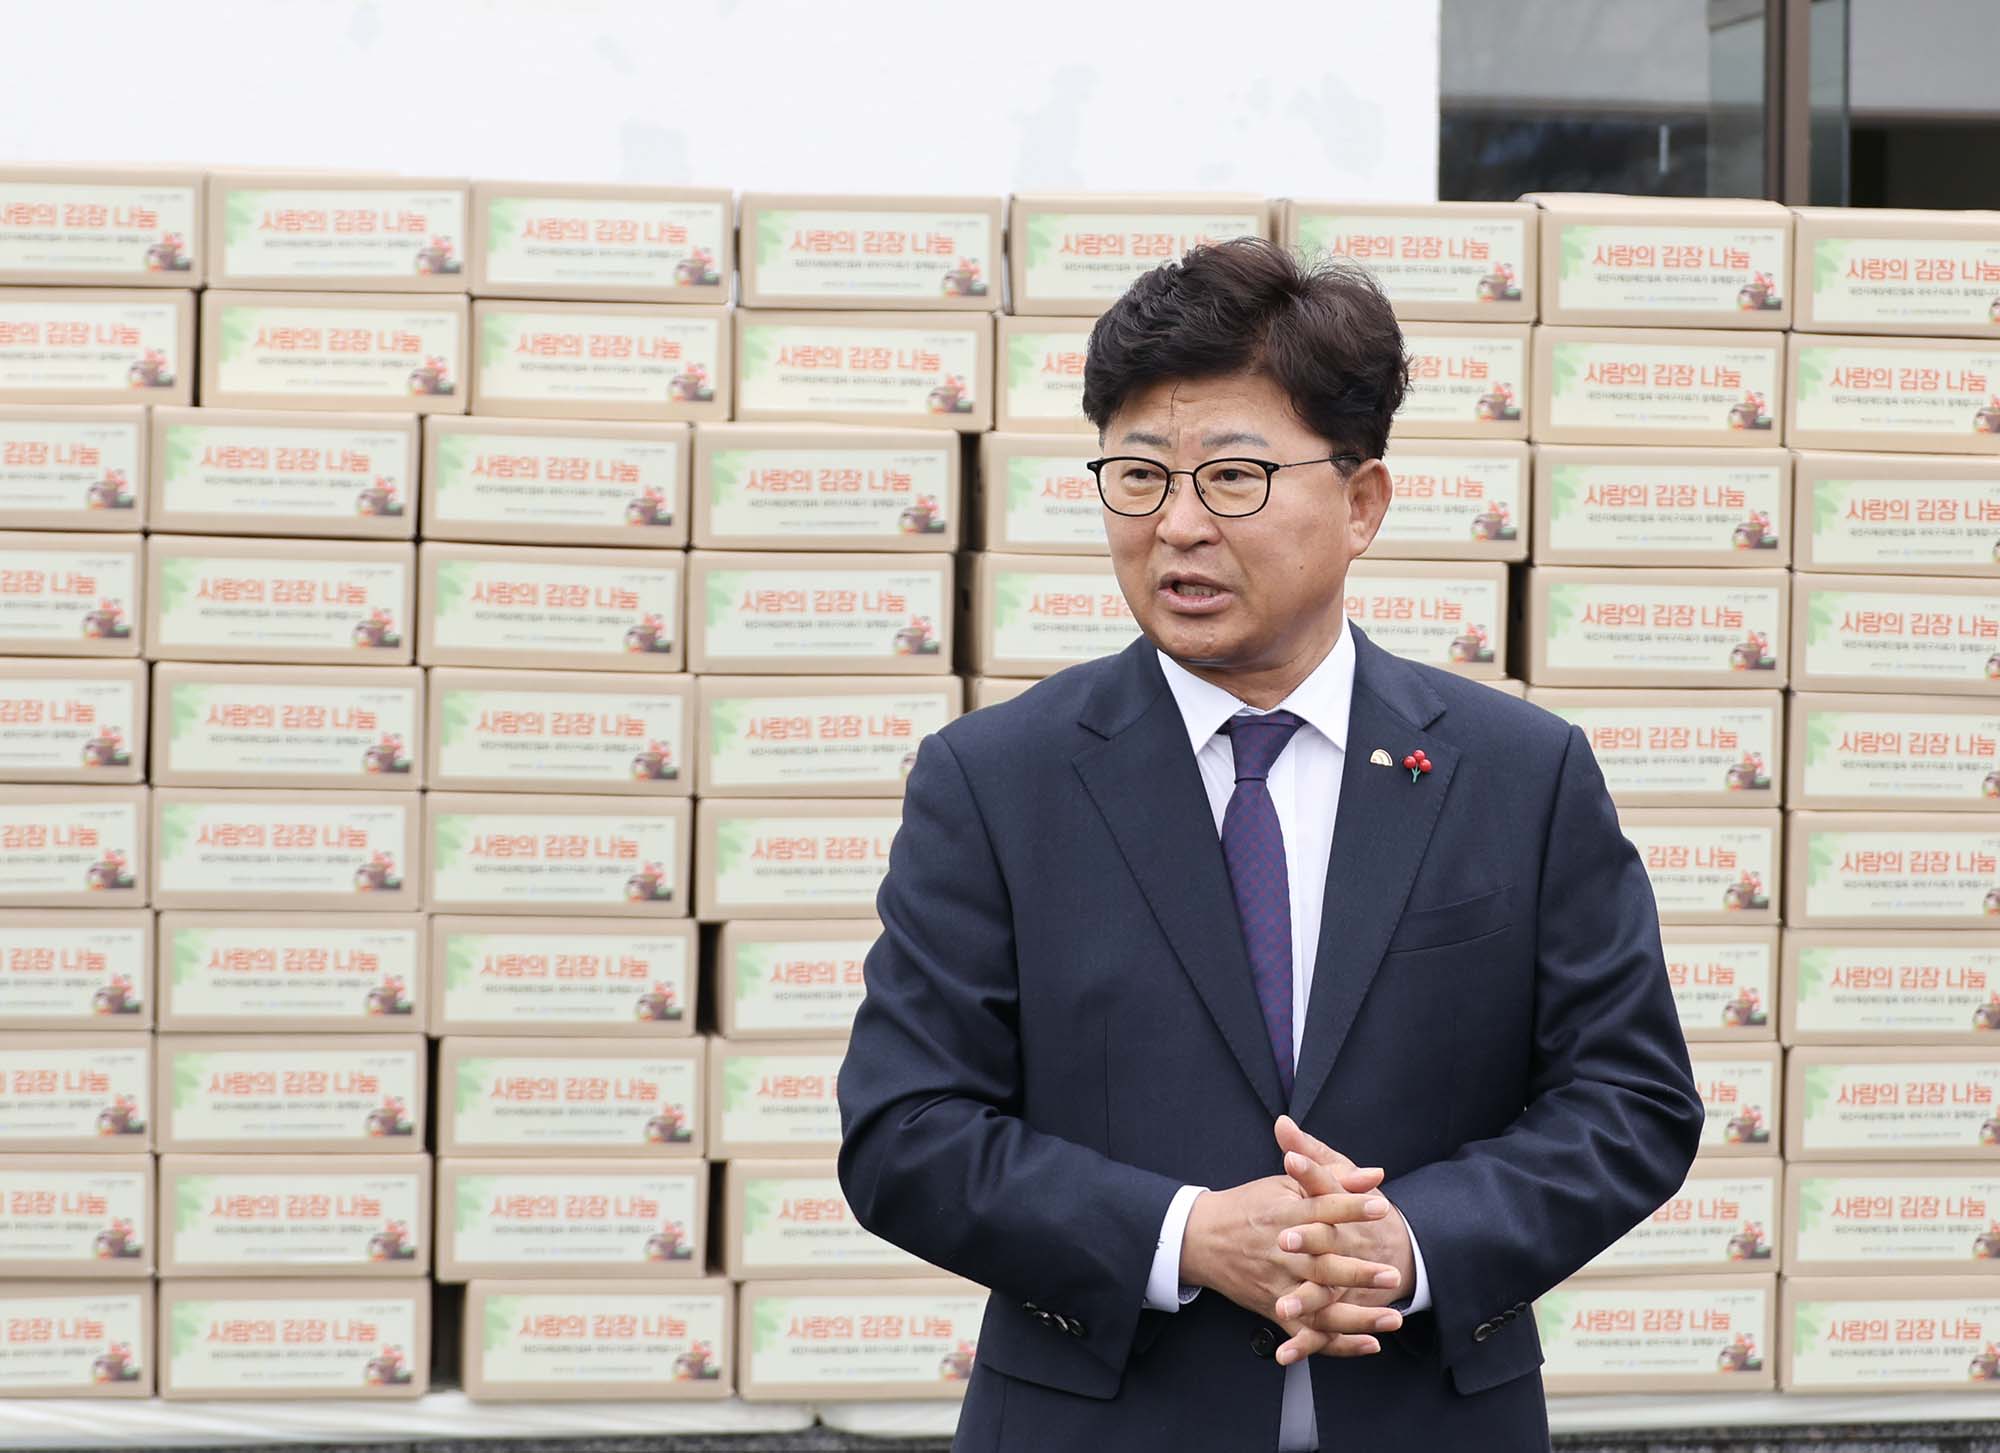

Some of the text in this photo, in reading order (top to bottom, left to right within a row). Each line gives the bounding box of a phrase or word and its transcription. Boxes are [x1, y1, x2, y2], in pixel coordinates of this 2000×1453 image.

[62, 205, 159, 231] 김장 나눔
[259, 209, 428, 236] 사랑의 김장 나눔
[522, 217, 689, 246] 사랑의 김장 나눔
[789, 230, 956, 257] 사랑의 김장 나눔
[1061, 233, 1173, 257] 사랑의 김장
[1331, 235, 1490, 262] 사랑의 김장 나눔
[1593, 244, 1752, 272] 사랑의 김장 나눔
[1846, 257, 2000, 288] 사랑의 김장 나눔
[46, 322, 145, 348] 김장 나눔
[255, 327, 422, 354] 사랑의 김장 나눔
[515, 334, 682, 361] 사랑의 김장 나눔
[776, 345, 944, 375] 사랑의 김장 나눔
[1584, 362, 1742, 388] 사랑의 김장 나눔
[1828, 367, 1987, 394] 사랑의 김장 나눔
[2, 441, 100, 469] 김장 나눔
[201, 447, 372, 475] 사랑의 김장 나눔
[472, 453, 641, 485] 사랑의 김장 나눔
[744, 469, 913, 495] 사랑의 김장 나눔
[1392, 476, 1485, 501] 김장 나눔
[1583, 483, 1748, 512] 사랑의 김장 나눔
[1846, 498, 2000, 529] 사랑의 김장 나눔
[196, 579, 369, 608] 사랑의 김장 나눔
[469, 581, 640, 611] 사랑의 김장 나눔
[736, 590, 907, 616] 사랑의 김장 나눔
[1029, 593, 1094, 619] 사랑의
[1373, 595, 1463, 622] 김장 나눔
[1582, 602, 1745, 631] 사랑의 김장 나눔
[1839, 609, 2000, 641] 사랑의 김장 나눔
[0, 700, 96, 725] 김장 나눔
[205, 703, 379, 732] 사랑의 김장 나눔
[747, 714, 913, 743] 사랑의 김장 나눔
[1648, 727, 1740, 752] 김장 나눔
[1839, 731, 1998, 760] 사랑의 김장 나눔
[0, 825, 97, 851] 김장 나눔
[195, 824, 369, 850] 사랑의 김장 나눔
[468, 834, 640, 863] 사랑의 김장 나눔
[750, 835, 869, 863] 사랑의 김장
[1648, 846, 1737, 872] 김장 나눔
[1839, 851, 1999, 877] 사랑의 김장 나눔
[10, 949, 107, 974] 김장 나눔
[207, 949, 380, 975] 사랑의 김장 나눔
[771, 961, 837, 986] 사랑의
[1693, 965, 1735, 987] 나눔
[1828, 966, 1988, 993] 사랑의 김장 나눔
[489, 1077, 660, 1105] 사랑의 김장 나눔
[757, 1076, 824, 1101] 사랑의
[1836, 1082, 1994, 1108] 사랑의 김장 나눔
[208, 1195, 383, 1221] 사랑의 김장 나눔
[490, 1195, 658, 1221] 사랑의 김장 나눔
[777, 1200, 846, 1225] 사랑의
[1652, 1196, 1740, 1225] 김장 나눔
[1830, 1196, 1988, 1221] 사랑의 김장 나눔
[7, 1317, 105, 1344] 김장 나눔
[207, 1320, 379, 1345] 사랑의 김장 나눔
[517, 1315, 688, 1341] 사랑의 김장 나눔
[787, 1315, 954, 1342] 사랑의 김장 나눔
[1573, 1309, 1732, 1335] 사랑의 김장 나눔
[1828, 1319, 1984, 1345] 사랑의 김장 나눔
